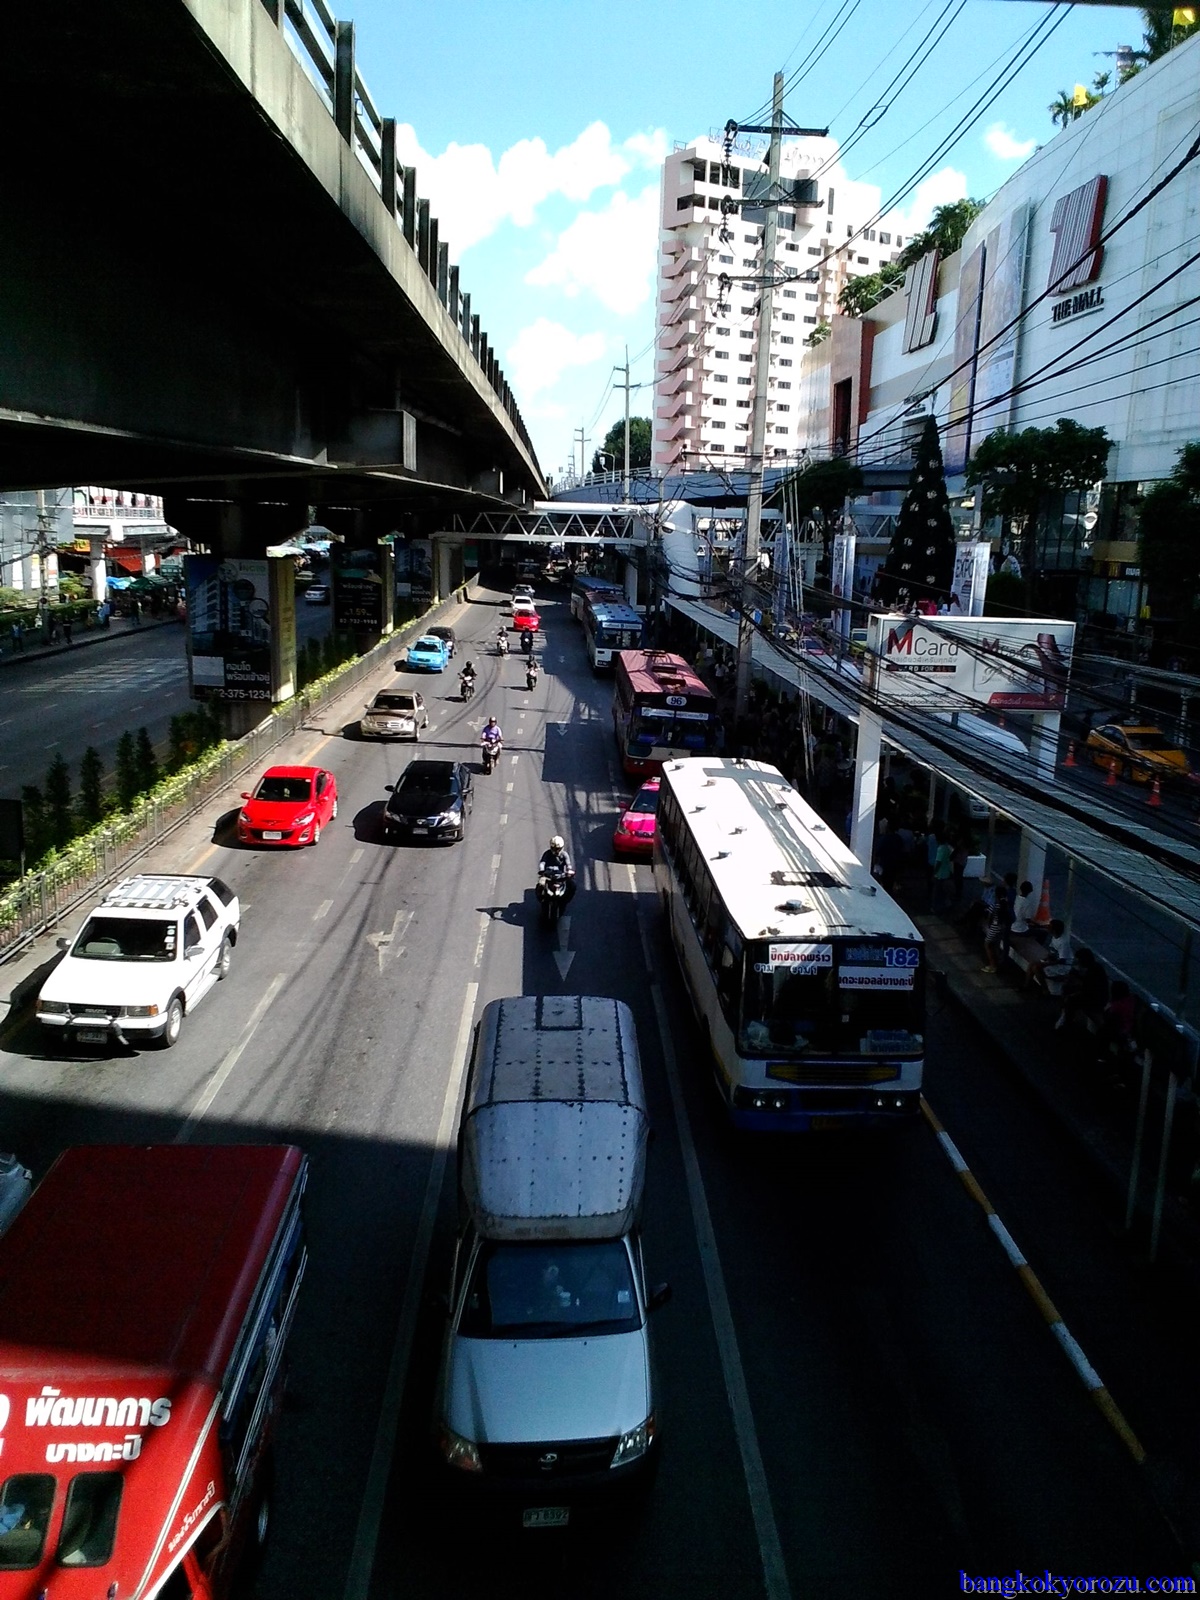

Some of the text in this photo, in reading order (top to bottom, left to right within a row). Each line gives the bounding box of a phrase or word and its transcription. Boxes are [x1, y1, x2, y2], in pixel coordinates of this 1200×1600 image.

[1051, 286, 1105, 322] THE MALL
[887, 628, 959, 656] MCard
[670, 697, 683, 705] 96
[884, 947, 919, 967] 182
[25, 1386, 172, 1427] พัฒนาการ
[45, 1435, 142, 1463] บางกะปิ
